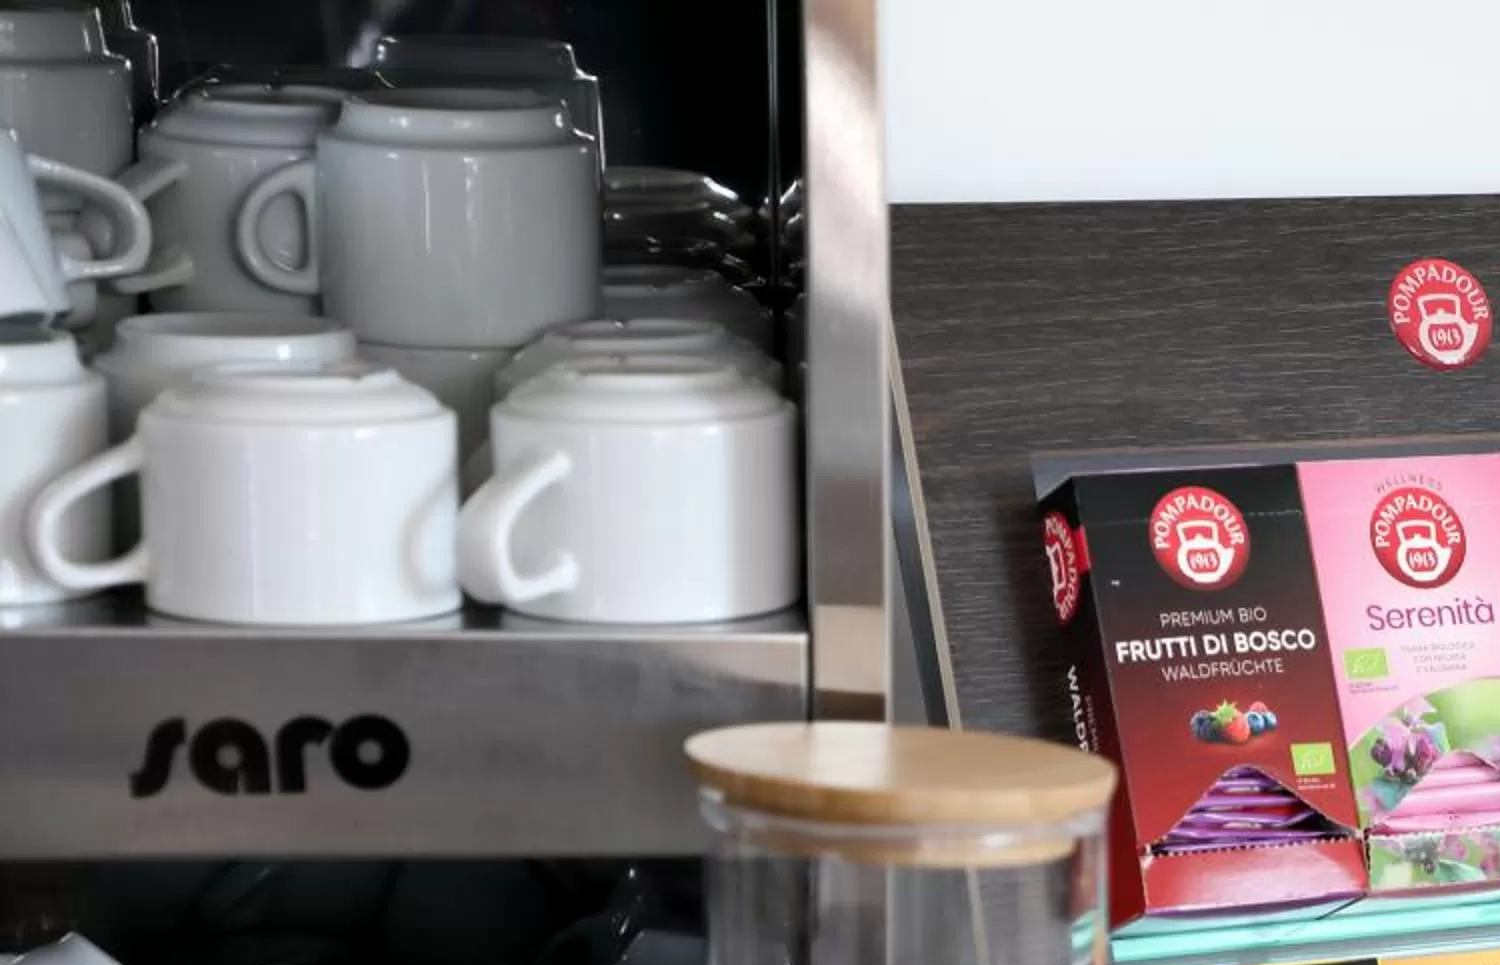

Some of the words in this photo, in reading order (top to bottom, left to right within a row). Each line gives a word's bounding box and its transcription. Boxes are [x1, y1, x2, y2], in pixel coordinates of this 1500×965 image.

[1393, 264, 1489, 324] POMPADOUR
[1432, 328, 1461, 346] 1913
[1155, 491, 1245, 549] POMPADOUR
[1375, 493, 1460, 548] POMPADOUR
[1409, 552, 1436, 568] 1913
[1159, 609, 1234, 628] PREMIUM
[1239, 606, 1267, 623] BIO
[1366, 595, 1495, 631] Serenità
[1115, 636, 1197, 663] FRUTTI
[1204, 633, 1227, 655] DI
[1235, 629, 1316, 654] BOSCO
[1162, 658, 1285, 682] WALDFRÜCHTE
[131, 712, 411, 796] saro
